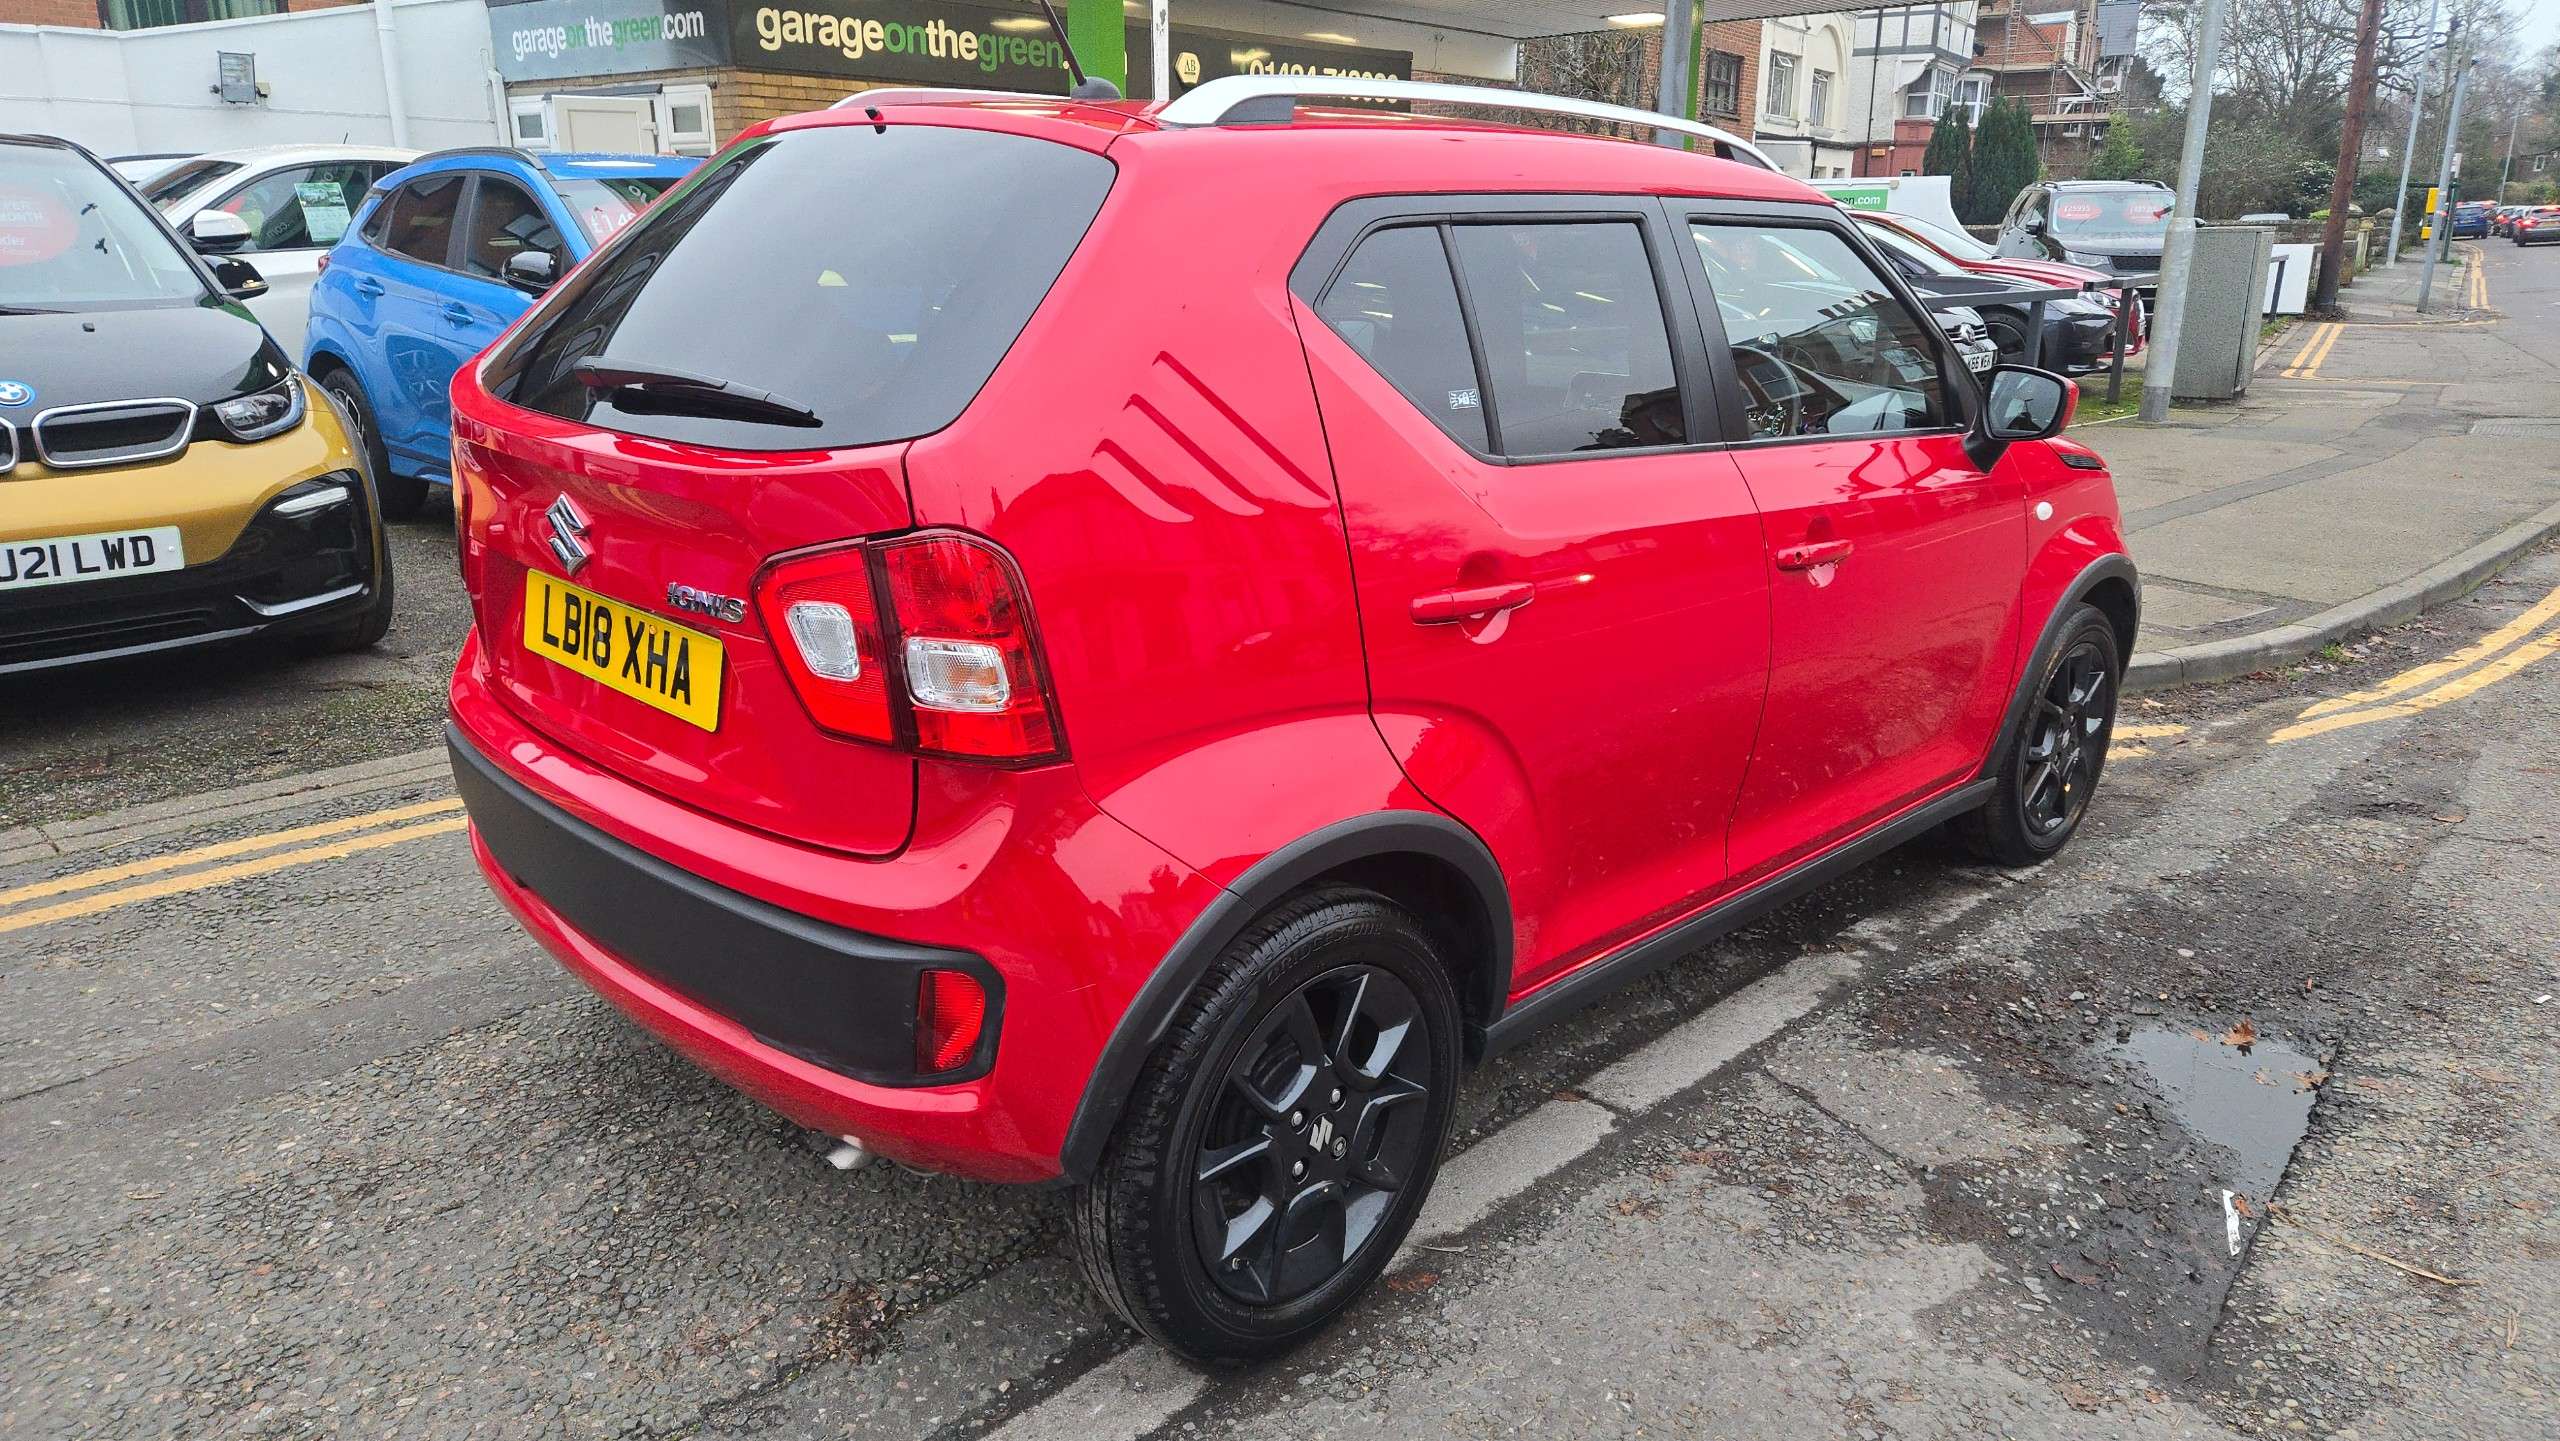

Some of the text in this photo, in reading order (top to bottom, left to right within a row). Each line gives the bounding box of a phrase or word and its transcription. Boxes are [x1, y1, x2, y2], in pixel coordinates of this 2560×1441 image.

[512, 10, 705, 61] garageonthegreen.com
[72, 535, 156, 574] LWD
[666, 582, 747, 623] IGNIS
[542, 583, 691, 706] LB18 XHA
